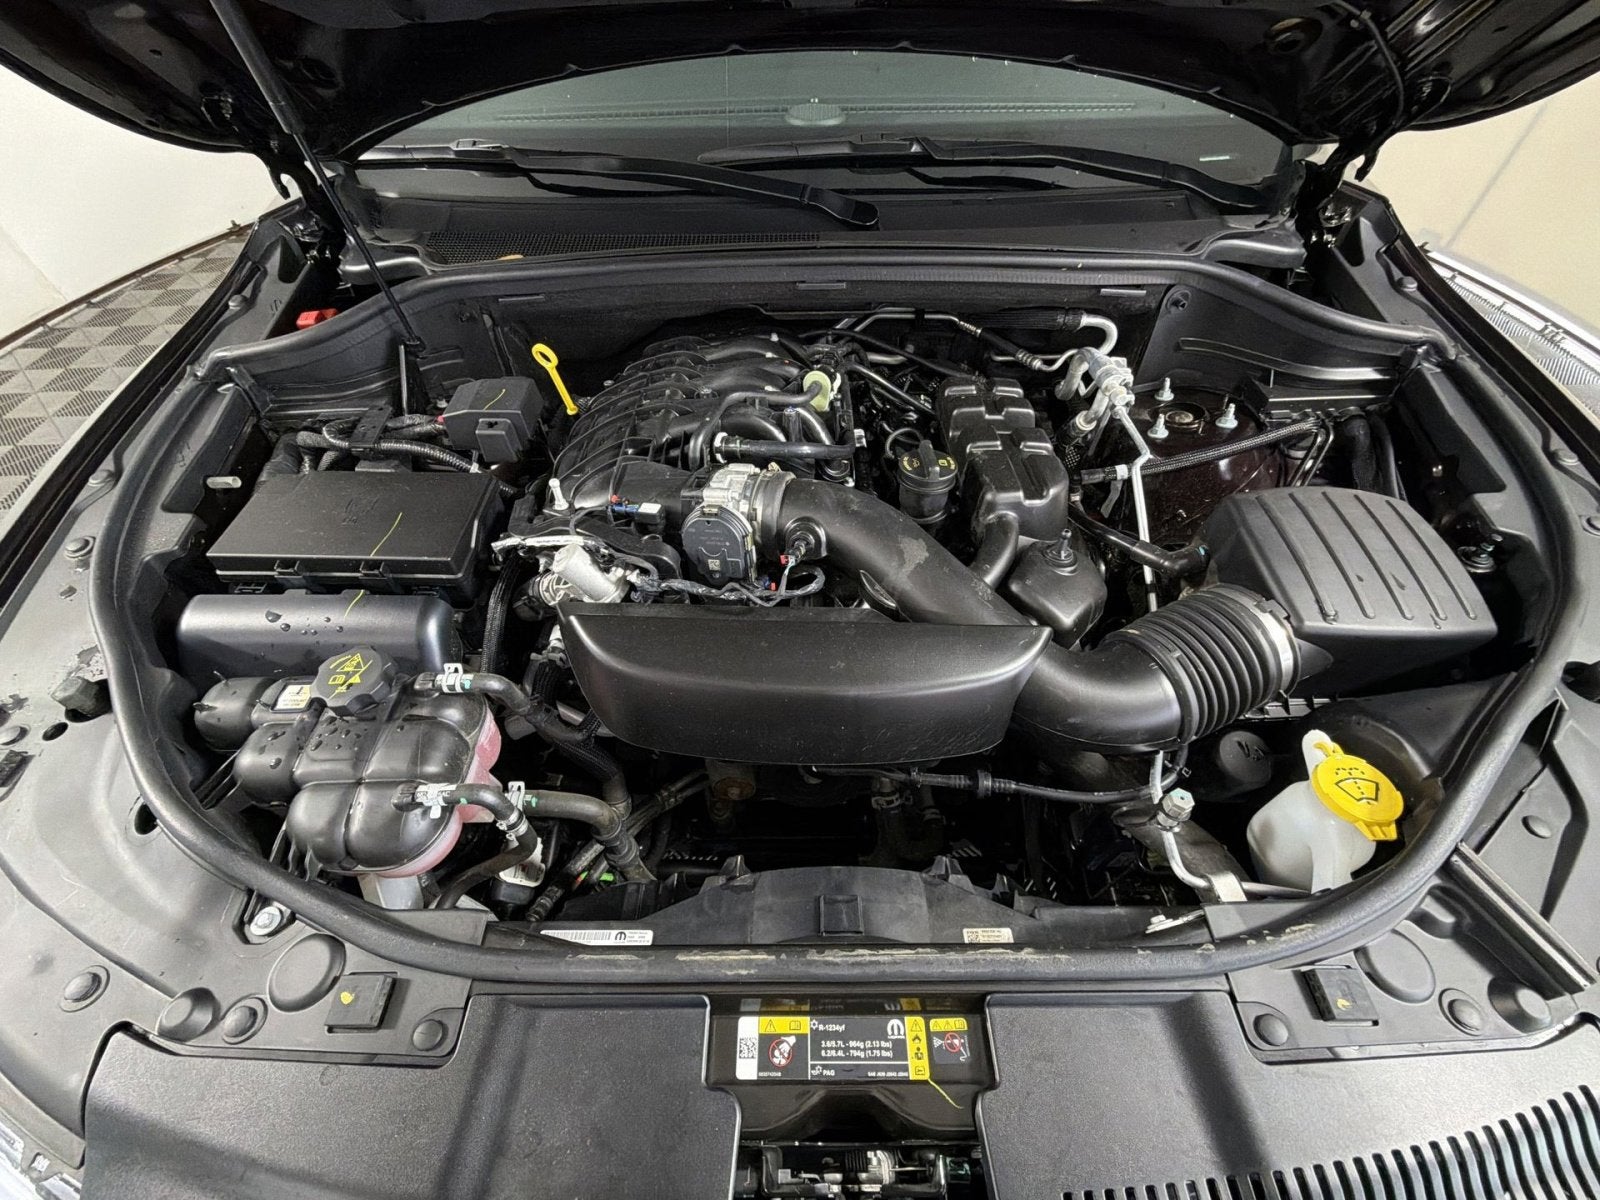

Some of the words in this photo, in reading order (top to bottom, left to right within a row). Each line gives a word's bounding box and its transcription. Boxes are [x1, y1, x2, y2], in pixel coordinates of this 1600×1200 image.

[818, 1024, 846, 1033] R-1234yf
[880, 1040, 893, 1049] lbs)
[881, 1049, 893, 1058] lbs)
